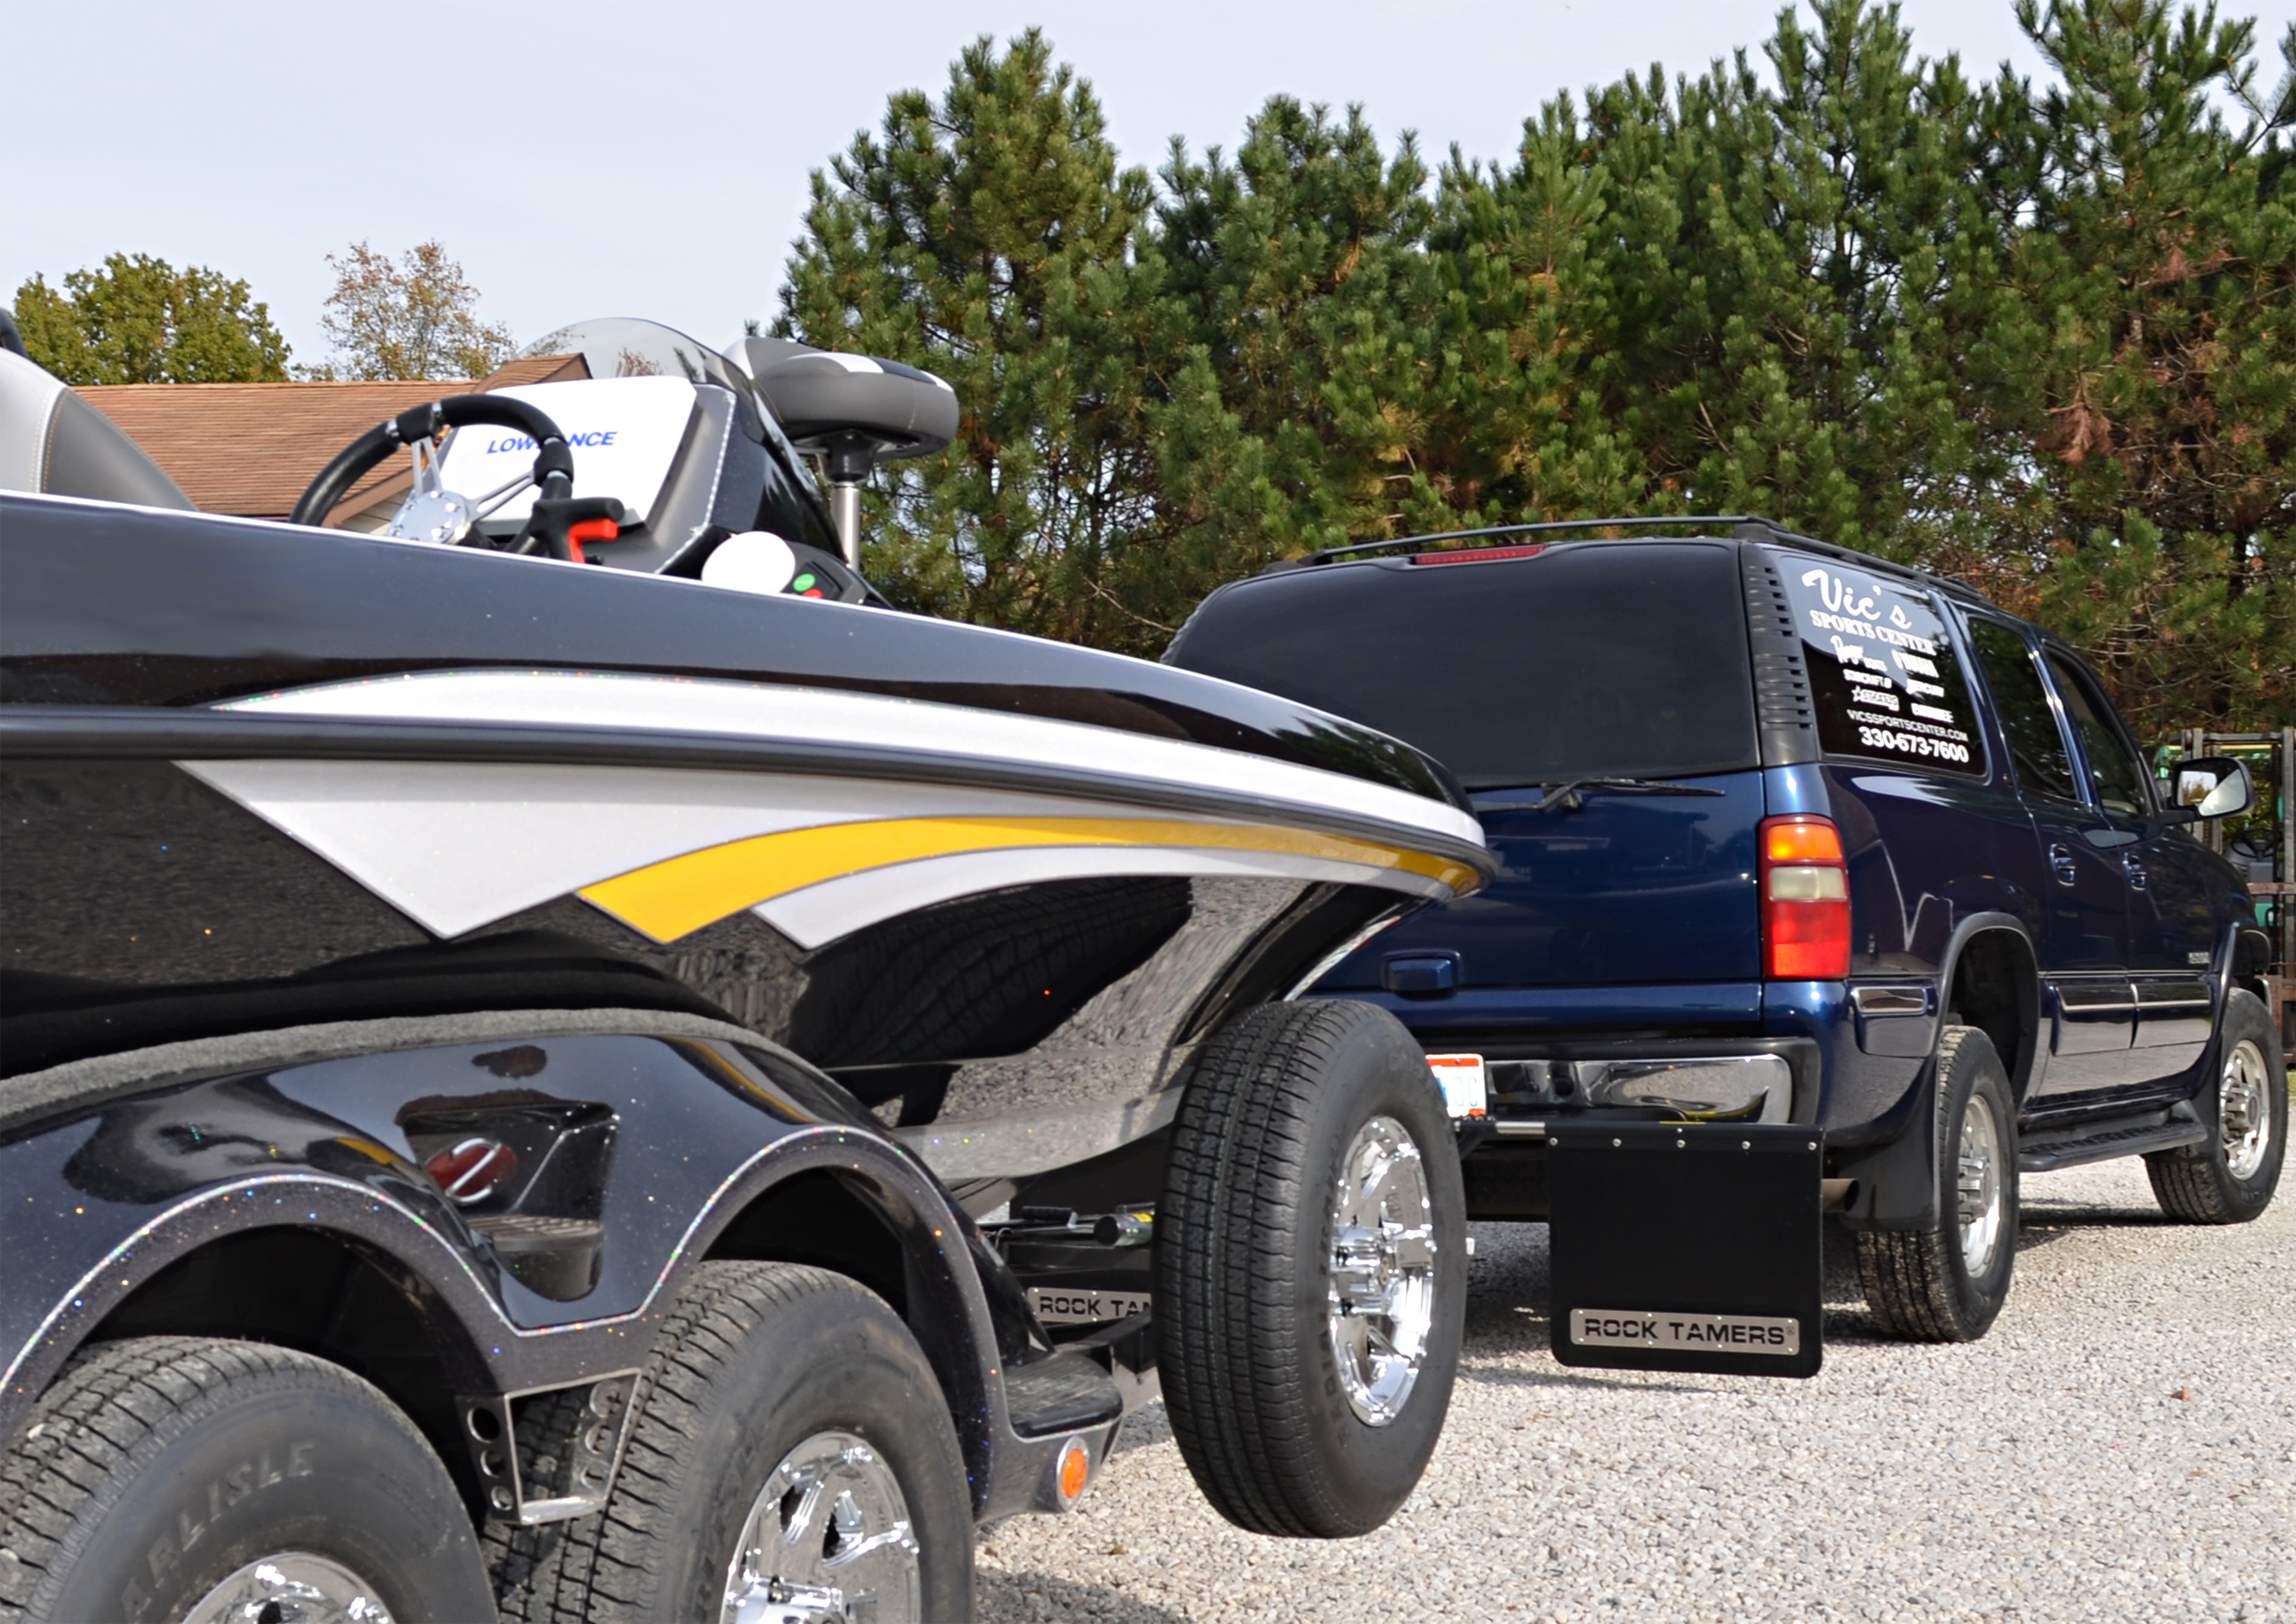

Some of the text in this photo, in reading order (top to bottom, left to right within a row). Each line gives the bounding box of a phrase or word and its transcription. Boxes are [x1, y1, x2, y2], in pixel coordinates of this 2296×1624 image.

[487, 431, 617, 454] LOWNCE
[1809, 610, 1876, 639] SPORTS
[1876, 626, 1937, 656] CENTER
[1847, 709, 1968, 741] VICSSPORTSCENTER.COM
[1859, 727, 1969, 763] 330-673-7600
[1039, 1296, 1102, 1316] ROCK
[1584, 1318, 1785, 1345] ROCK TAMERS
[120, 1439, 318, 1624] ARLISLE
